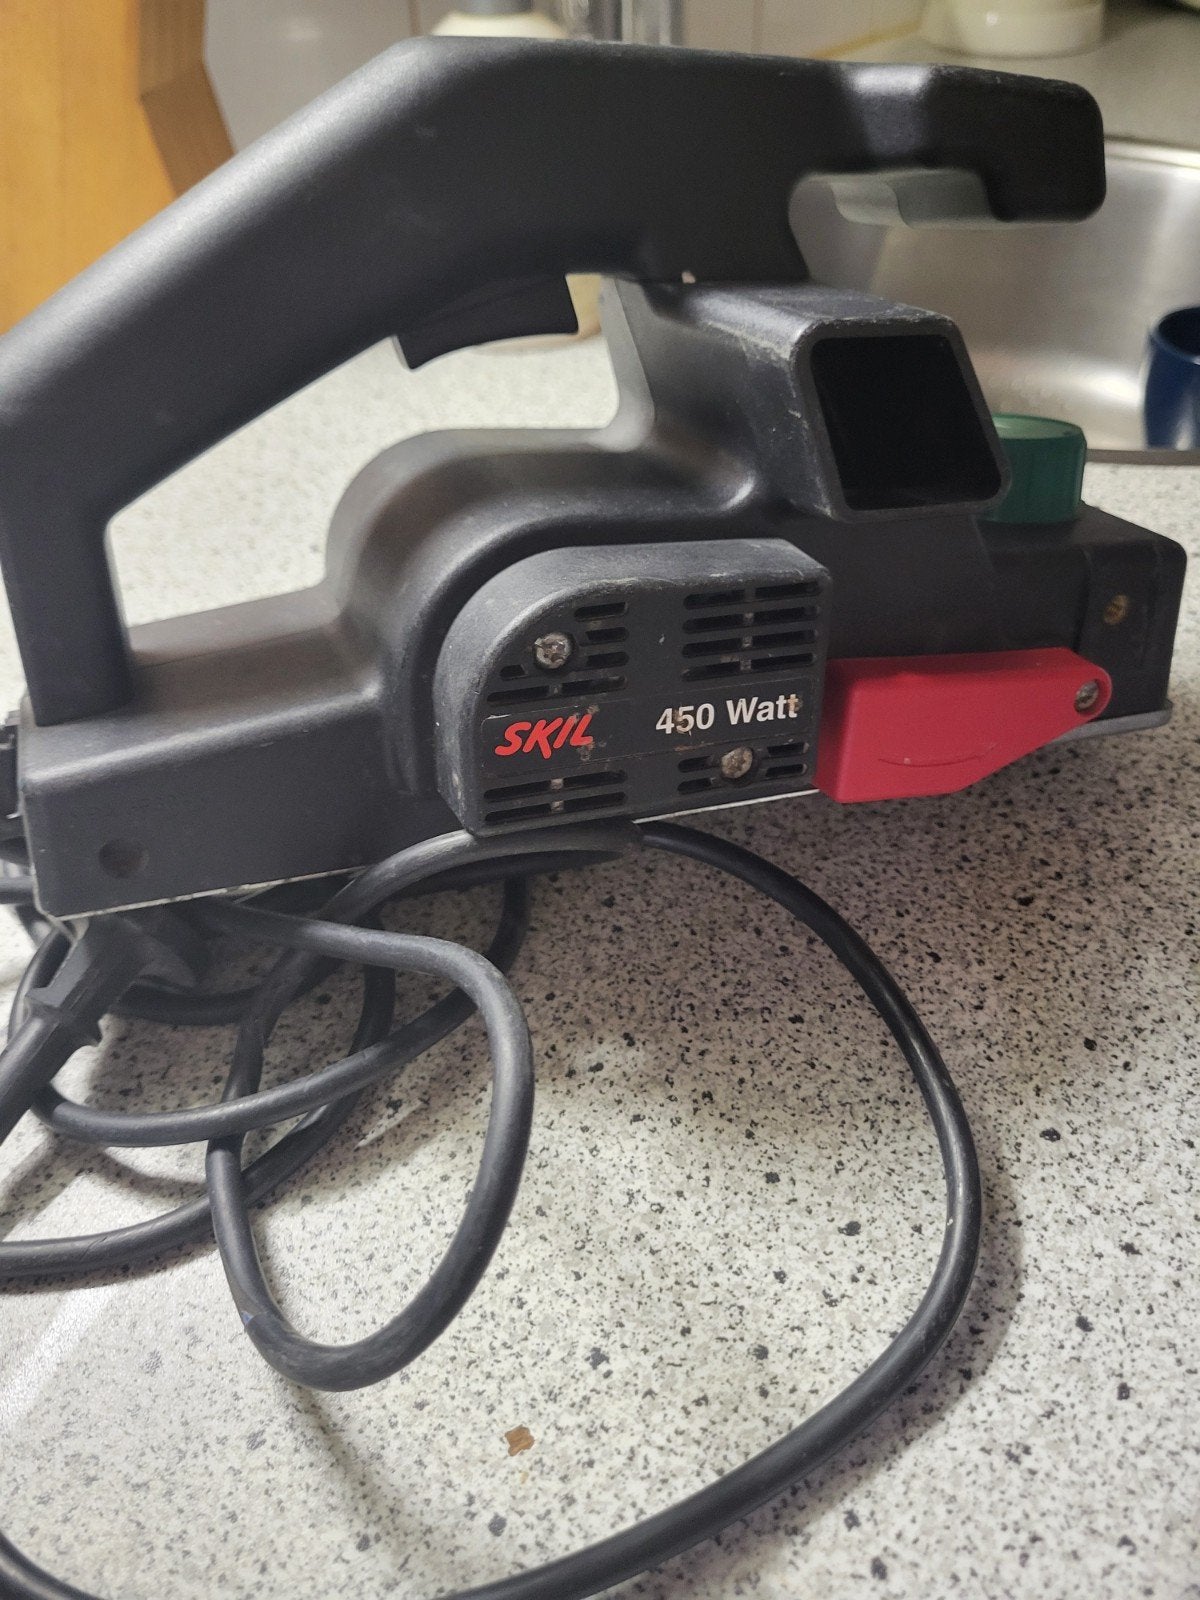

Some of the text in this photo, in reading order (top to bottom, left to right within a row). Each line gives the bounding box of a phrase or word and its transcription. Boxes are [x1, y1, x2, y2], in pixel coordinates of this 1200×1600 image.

[494, 713, 594, 759] SKIL
[655, 693, 799, 735] 450 Watt
